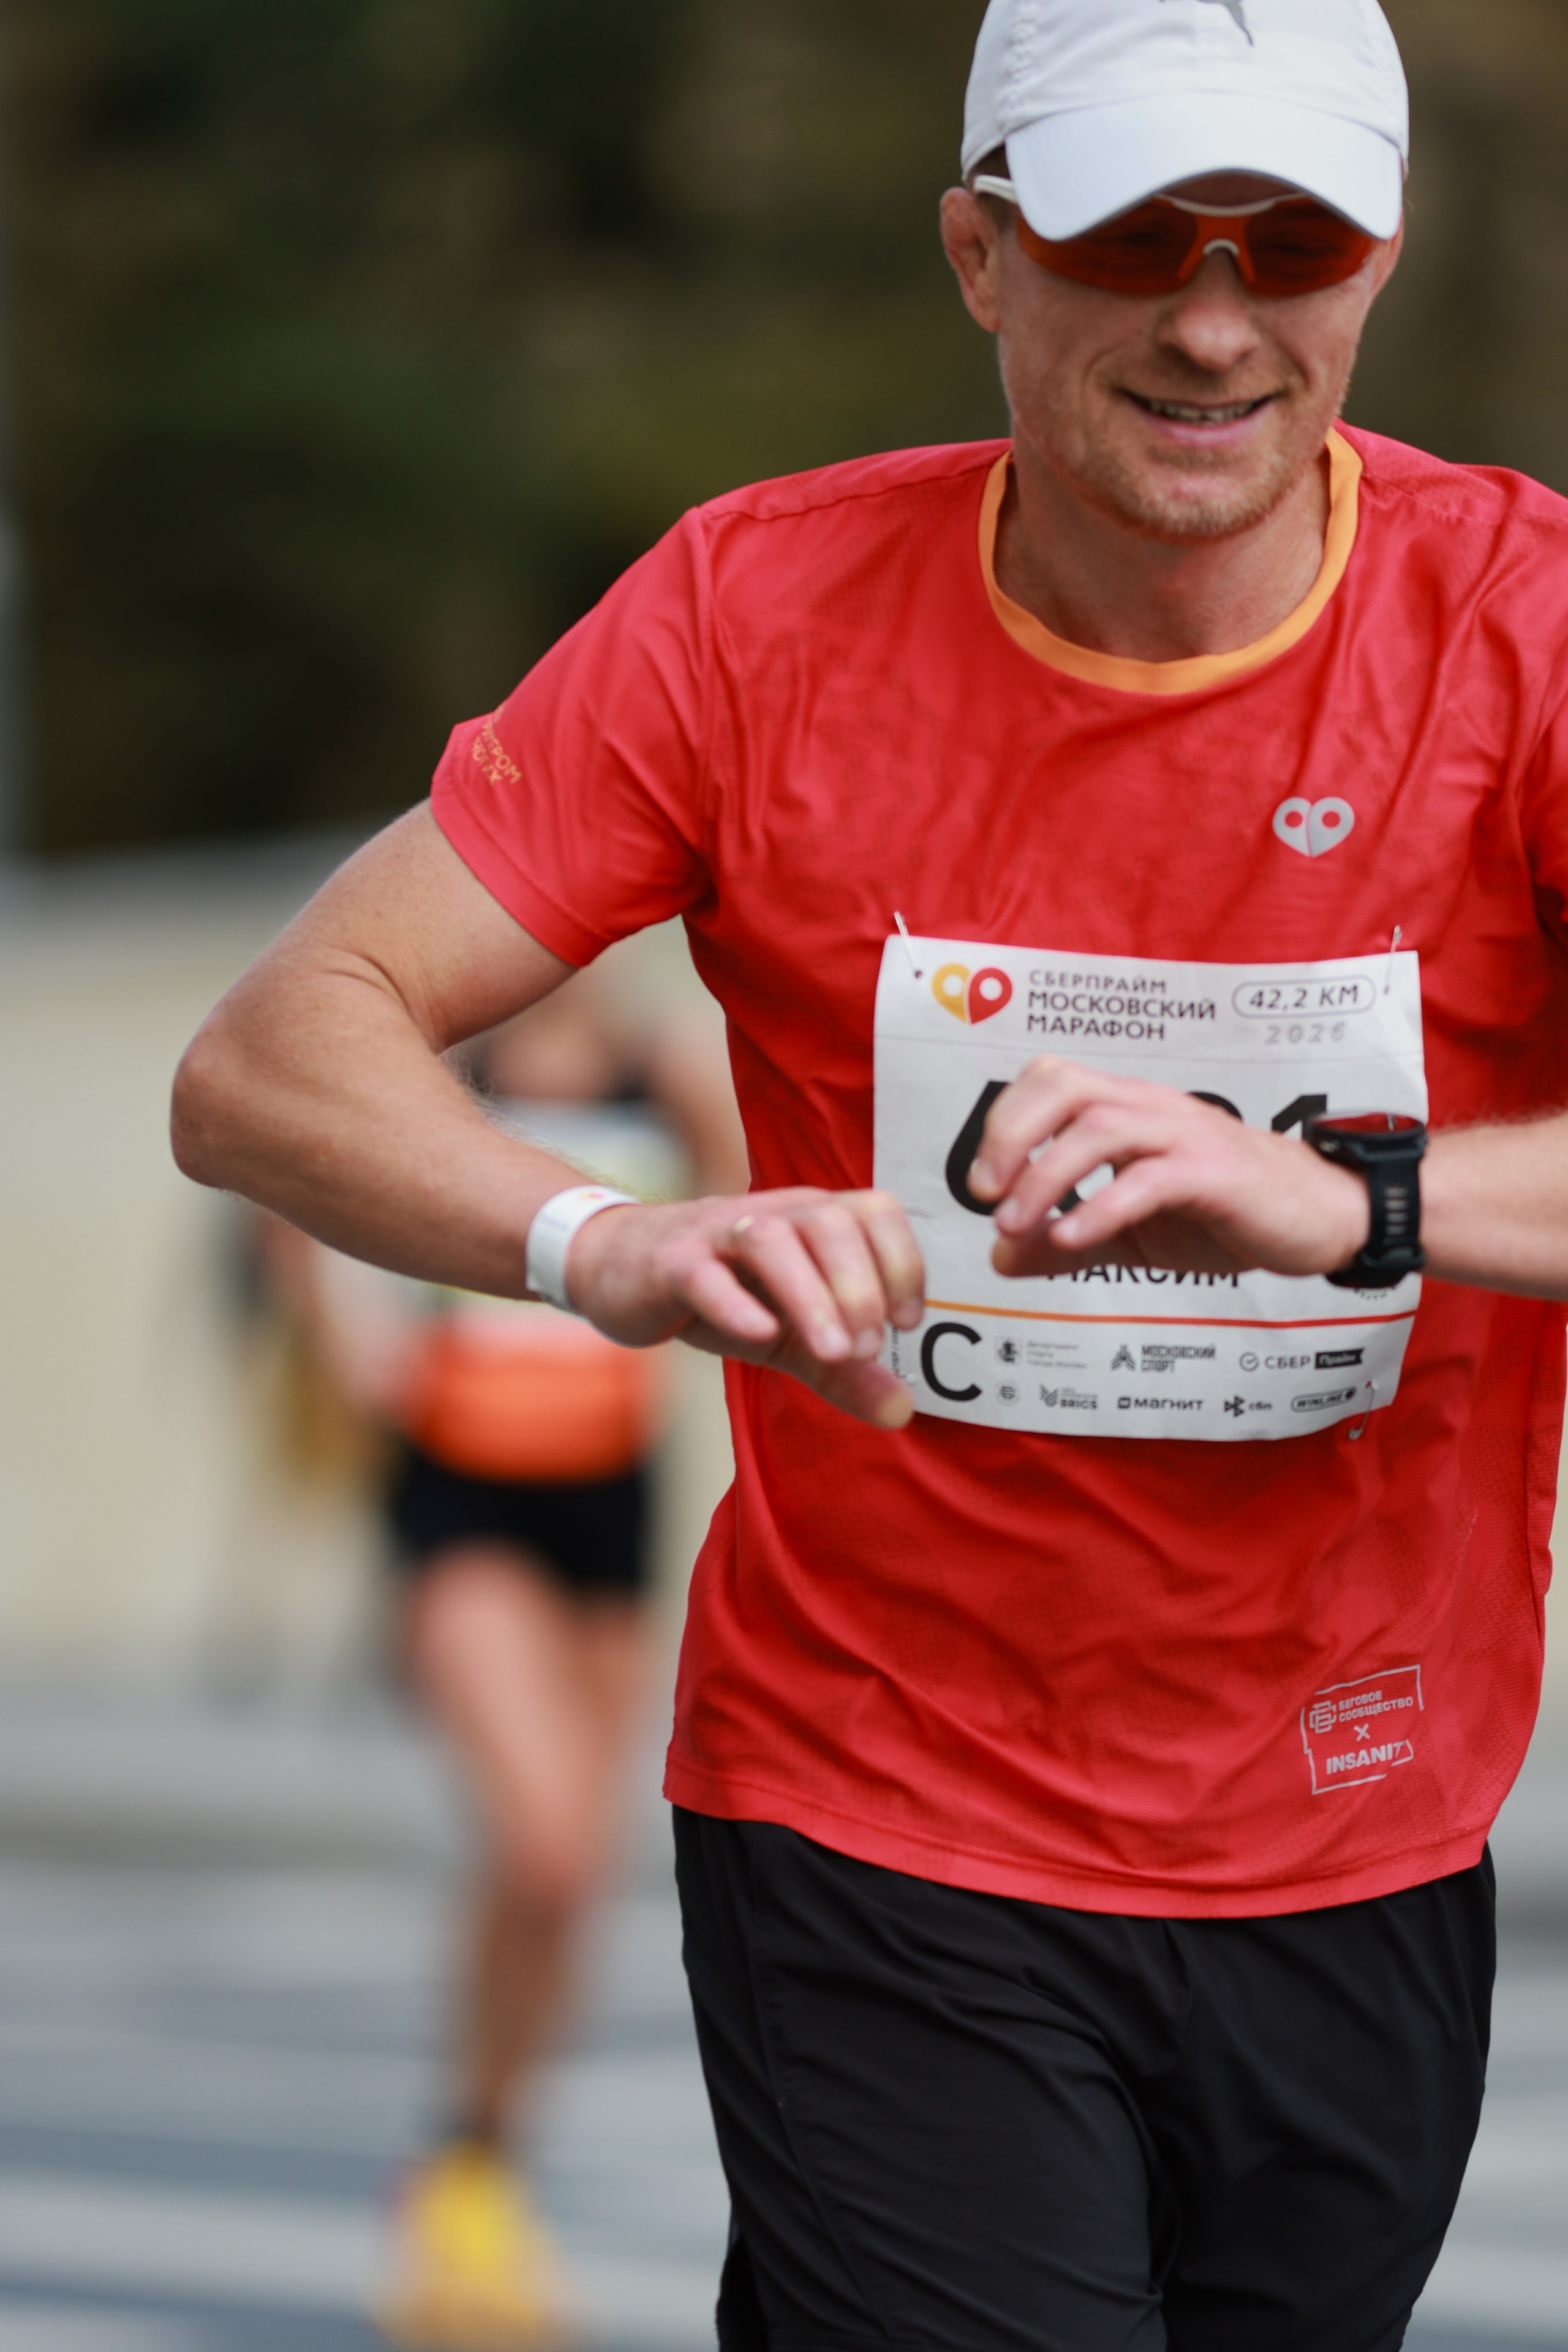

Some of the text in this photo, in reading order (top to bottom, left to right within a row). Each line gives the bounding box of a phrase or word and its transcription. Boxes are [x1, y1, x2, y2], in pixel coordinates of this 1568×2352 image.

[1029, 969, 1166, 993] СБЕРПРАЙМ
[1028, 990, 1216, 1020] МОСКОВСКИЙ
[1250, 984, 1359, 1011] 42,2 КМ
[1027, 1014, 1165, 1040] МАРАФОН
[1264, 1021, 1346, 1044] 2026
[1265, 1355, 1311, 1369] СБЕР
[1338, 1690, 1382, 1711] БЕГОВОЕ
[1339, 1696, 1414, 1723] СООБЩЕСТВО
